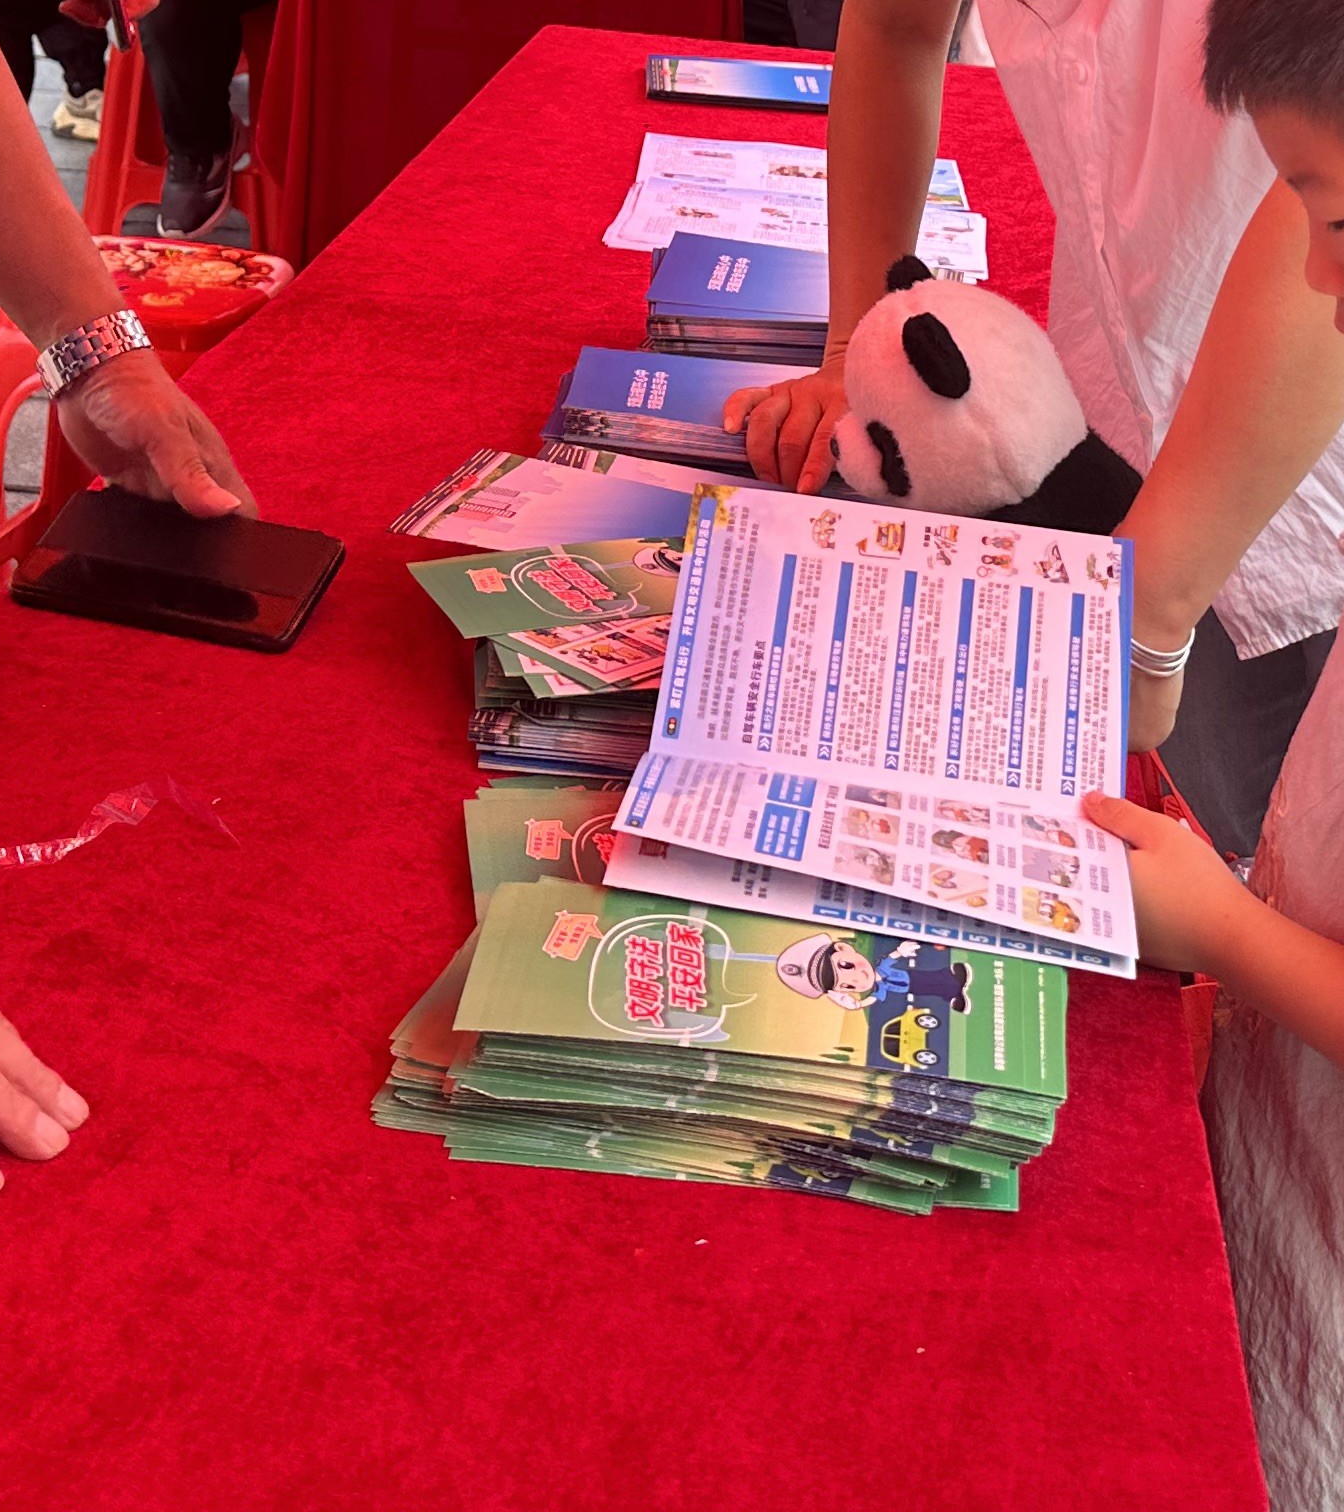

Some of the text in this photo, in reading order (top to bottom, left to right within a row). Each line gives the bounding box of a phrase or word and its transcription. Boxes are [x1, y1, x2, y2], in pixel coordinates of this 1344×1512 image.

[741, 638, 766, 744] 自驾车辆安全行车要点
[856, 913, 877, 924] 2
[893, 920, 914, 930] 3
[968, 933, 989, 944] 5
[1006, 940, 1027, 951] 6
[1081, 954, 1103, 964] 8
[666, 921, 708, 1012] 平安回家
[624, 934, 665, 1028] 文明守法
